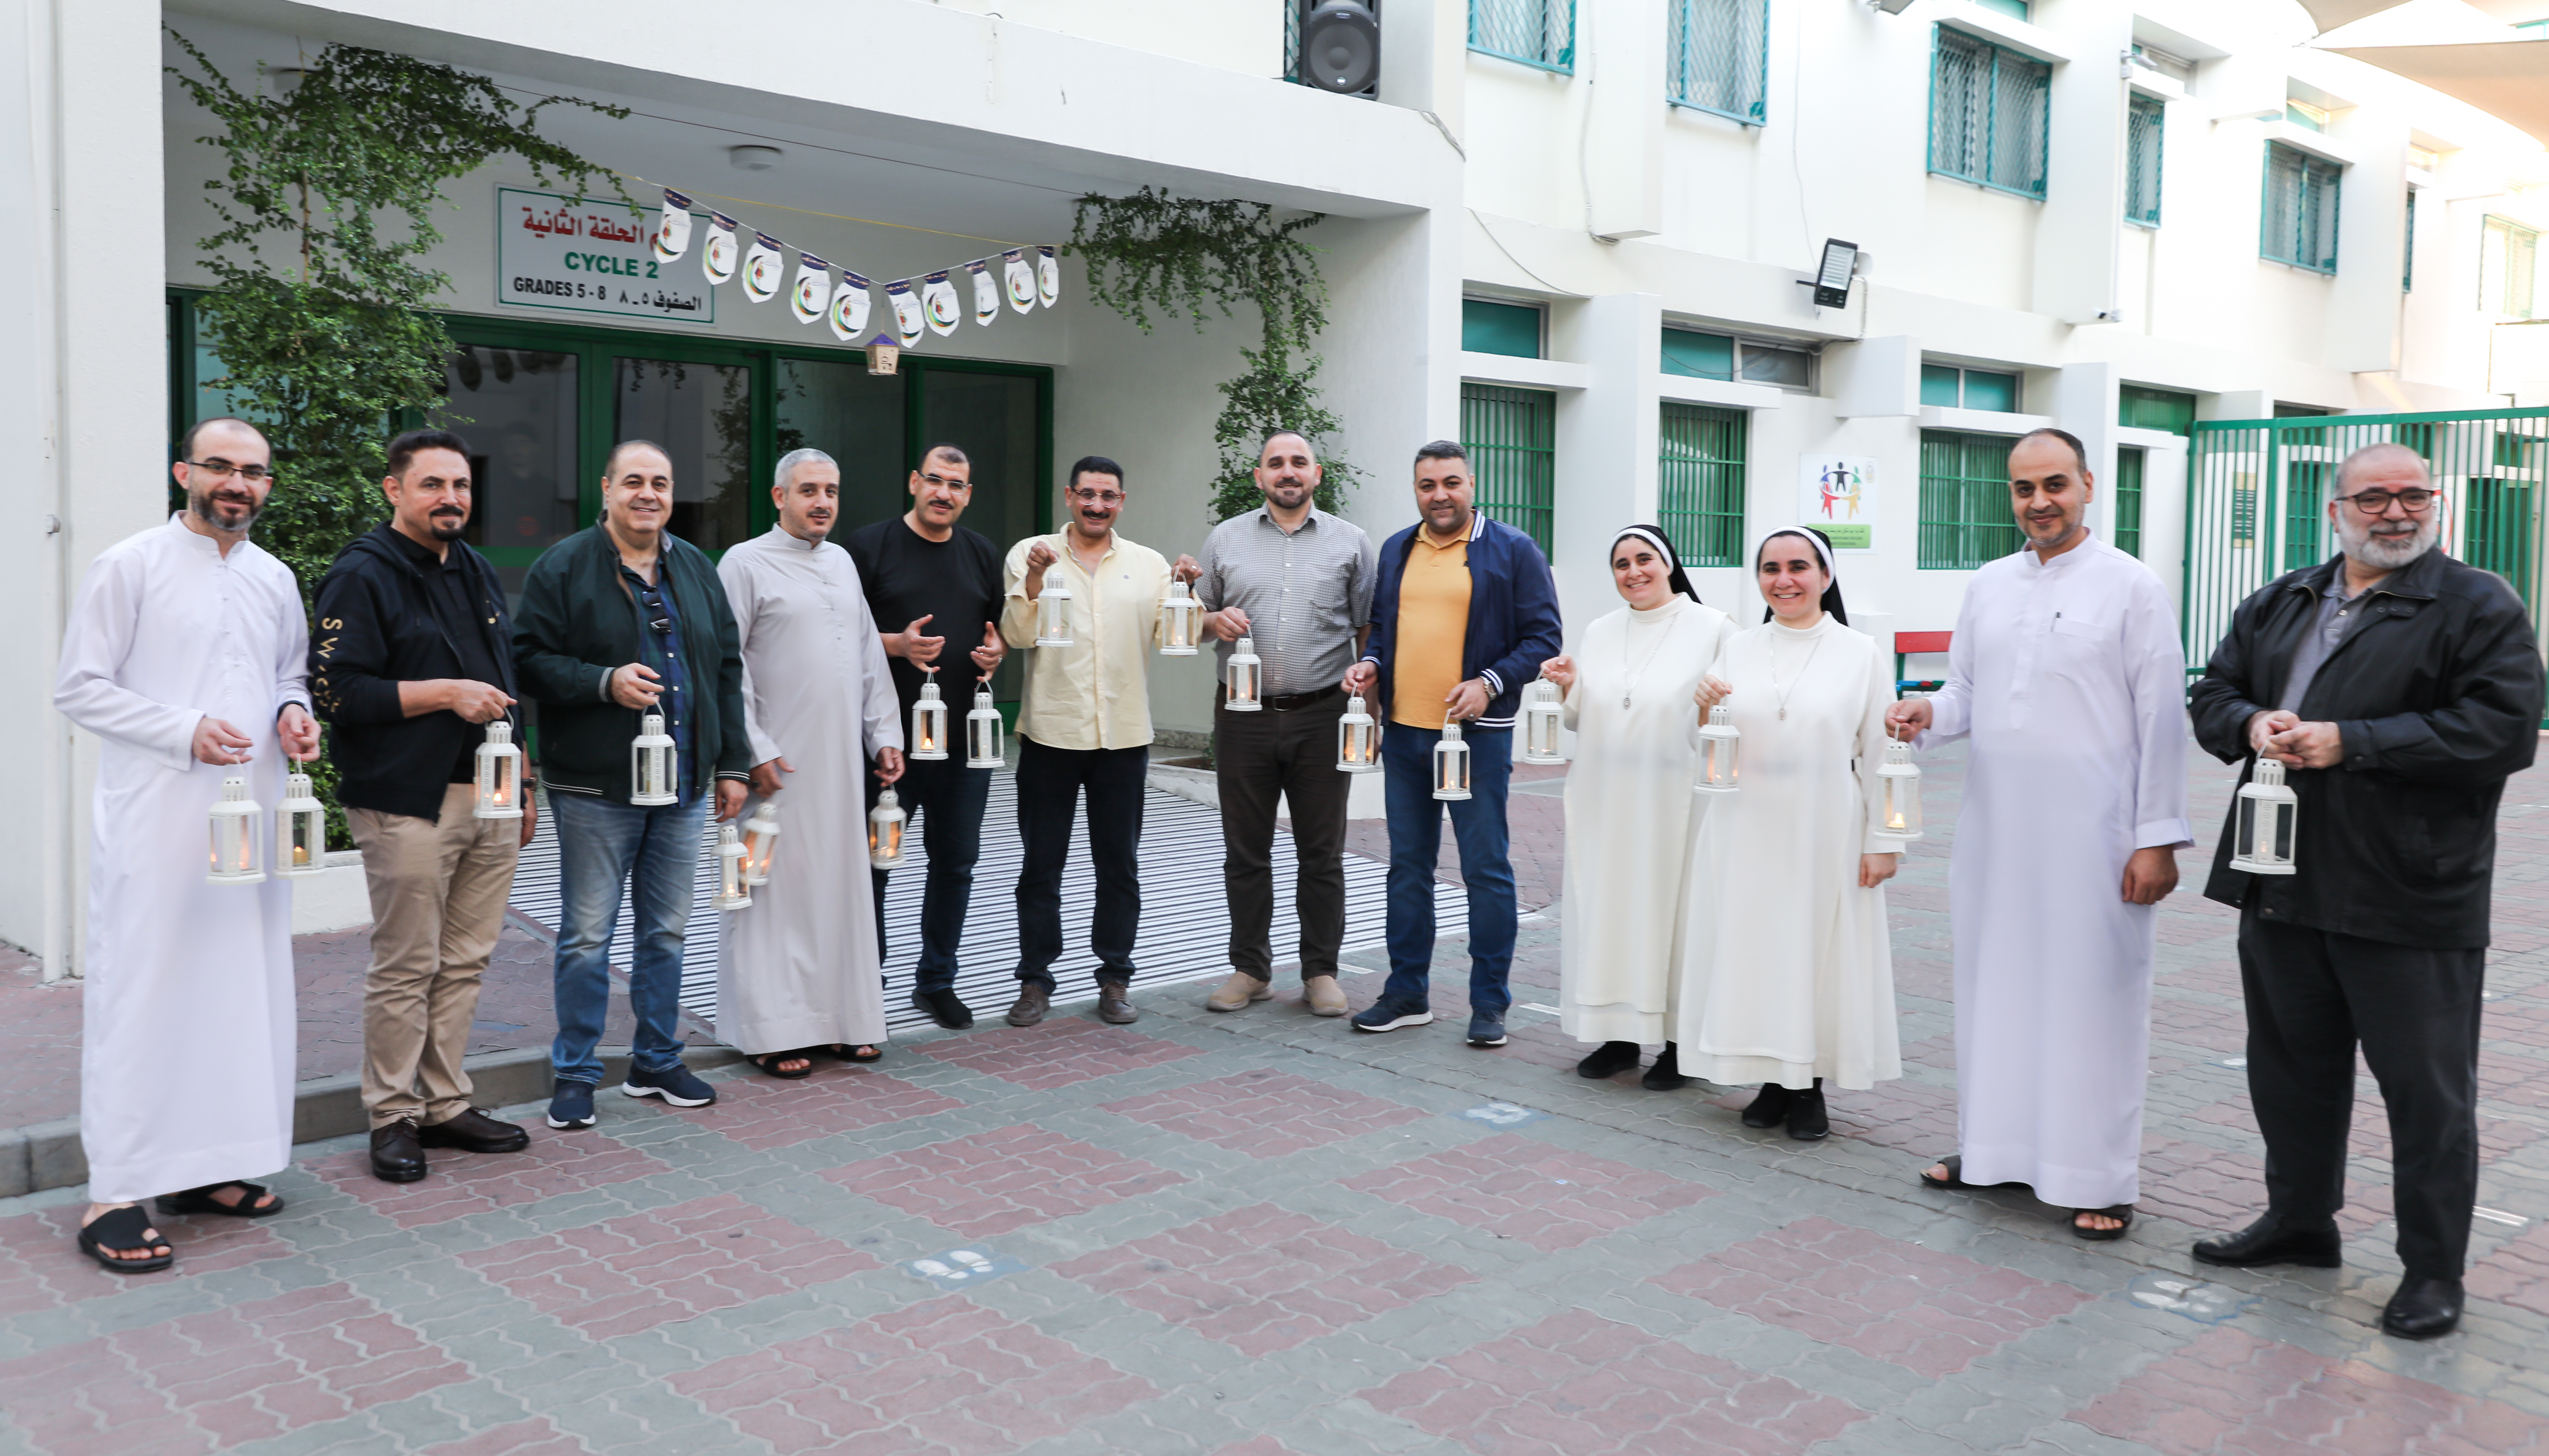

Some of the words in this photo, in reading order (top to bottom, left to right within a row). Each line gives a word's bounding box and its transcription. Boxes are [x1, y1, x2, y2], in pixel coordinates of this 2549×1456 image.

[522, 206, 582, 238] الثانية
[587, 215, 645, 243] الحلقة
[564, 252, 638, 276] CYCLE
[646, 261, 658, 279] 2
[514, 277, 572, 296] GRADES
[577, 283, 585, 298] 5
[598, 286, 606, 300] 8
[619, 291, 628, 303] ٨
[642, 293, 649, 305] ٥
[653, 291, 701, 312] الصفوف
